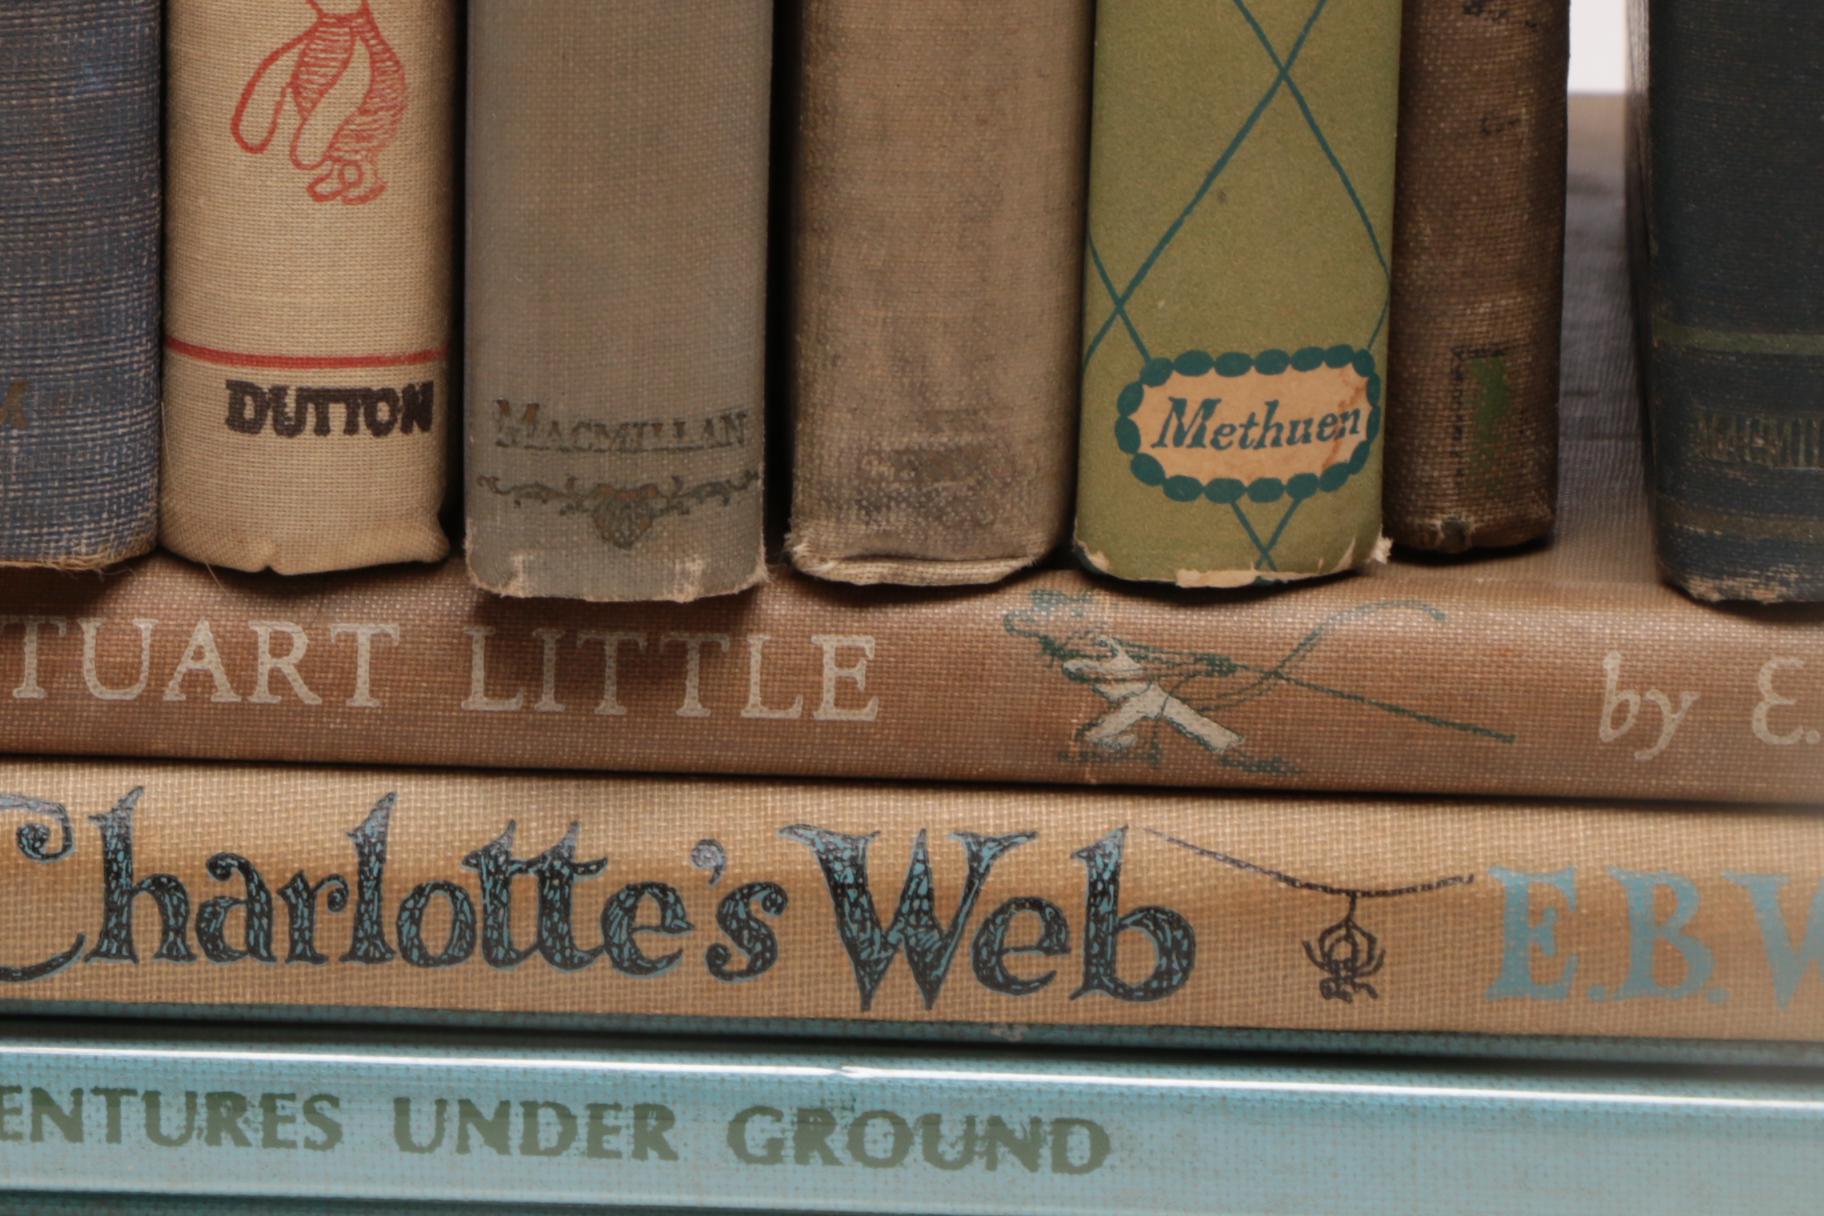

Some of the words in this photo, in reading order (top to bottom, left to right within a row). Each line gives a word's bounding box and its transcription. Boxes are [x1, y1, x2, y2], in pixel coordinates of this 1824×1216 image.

[225, 379, 434, 438] DUTTON
[1151, 395, 1362, 451] Methuen
[461, 626, 880, 722] LITTLE
[1599, 650, 1703, 761] by
[778, 821, 1197, 1012] Web
[391, 1095, 679, 1163] UNDER
[725, 1104, 1112, 1176] GROUND
